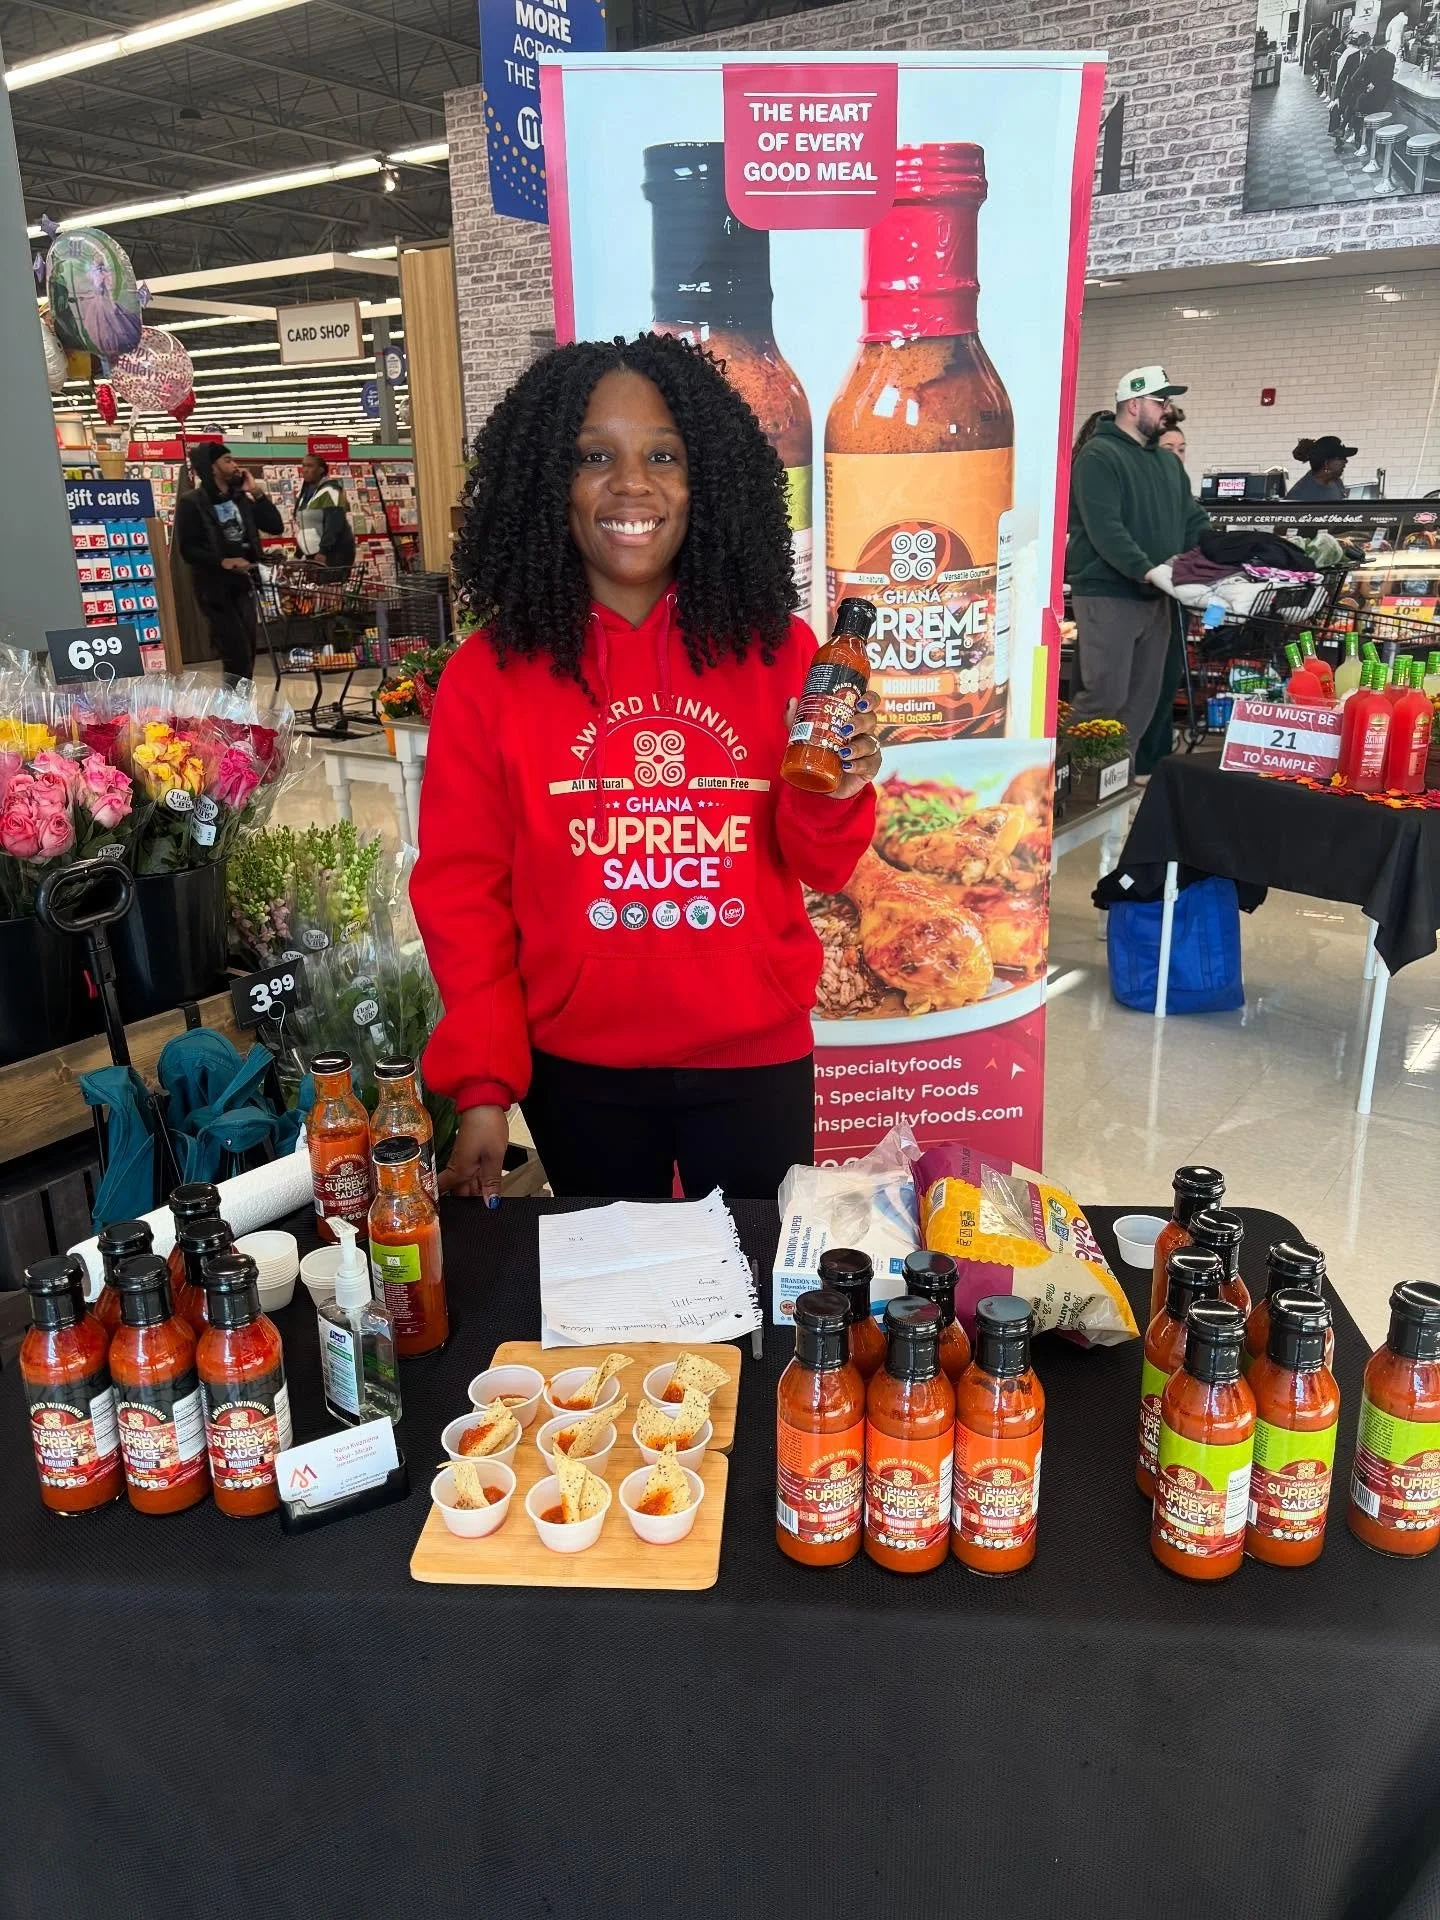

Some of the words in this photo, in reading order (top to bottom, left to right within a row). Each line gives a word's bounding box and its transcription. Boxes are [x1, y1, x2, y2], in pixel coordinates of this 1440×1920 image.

[515, 1, 572, 44] MORE
[504, 60, 536, 90] THE
[749, 103, 793, 122] THE
[799, 103, 872, 122] HEART
[758, 132, 789, 151] OF
[795, 132, 864, 151] EVERY
[743, 162, 811, 181] GOOD
[817, 162, 878, 181] MEAL
[287, 327, 317, 342] CARD
[320, 323, 350, 340] SHOP
[1217, 479, 1245, 490] meijer
[66, 488, 93, 509] gift
[98, 489, 140, 506] cards
[95, 537, 106, 547] 25
[80, 570, 92, 580] 25
[101, 569, 111, 579] 25
[944, 571, 969, 580] Versatile
[882, 588, 941, 604] GHANA
[86, 603, 96, 613] 25
[103, 602, 114, 612] 25
[869, 600, 988, 640] PREME
[885, 700, 936, 712] Medium
[1245, 702, 1273, 718] YOU
[1276, 706, 1314, 724] MUST
[1317, 712, 1337, 726] BE
[571, 696, 643, 761] AWRD
[1270, 729, 1297, 750] 21
[1242, 751, 1260, 764] TO
[1262, 752, 1315, 773] SAMPLE
[571, 780, 585, 790] All
[587, 779, 624, 790] Ntural
[697, 778, 728, 788] Gluten
[730, 779, 749, 789] Free
[626, 796, 693, 813] GHANA
[569, 815, 751, 857] SUPREME
[603, 856, 720, 890] SAUCE
[660, 914, 674, 923] GMO
[724, 907, 741, 916] LOW
[829, 1086, 916, 1106] Specialty
[921, 1081, 979, 1099] Foods
[324, 1175, 368, 1192] SUPREME
[335, 1187, 363, 1200] SAUCE
[1031, 1199, 1042, 1214] THIN
[1063, 1291, 1071, 1301] TO
[46, 1402, 84, 1418] WINNING
[131, 1402, 166, 1421] WINNING
[212, 1402, 233, 1420] AWARD
[234, 1401, 270, 1415] WINNING
[40, 1429, 69, 1438] GHANA
[127, 1429, 153, 1438] GHANA
[212, 1430, 273, 1449] SUPREME
[225, 1429, 258, 1438] GHANA
[41, 1447, 78, 1458] SAUCE
[126, 1446, 160, 1460] SAUCE
[224, 1444, 265, 1459] SAUCE
[44, 1458, 74, 1468] MARINADE
[228, 1458, 262, 1468] MARINADE
[809, 1453, 835, 1472] AWARD
[901, 1458, 935, 1479] WINNING
[972, 1458, 998, 1472] AWARD
[1001, 1458, 1031, 1473] WINNING
[805, 1475, 862, 1501] SUPREME
[823, 1478, 852, 1490] GHANA
[886, 1486, 919, 1497] GHANA
[985, 1486, 1017, 1495] GHANA
[873, 1484, 936, 1509] SUPREME
[967, 1487, 1032, 1507] SUPREME
[1159, 1480, 1221, 1515] SUPREME
[1173, 1485, 1198, 1500] GHANA
[818, 1493, 855, 1512] SAUCE
[1281, 1499, 1321, 1510] SAUCE
[882, 1504, 924, 1518] SAUCE
[980, 1504, 1021, 1518] SAUCE
[1165, 1500, 1206, 1525] SAUCE
[889, 1526, 915, 1535] Medium
[986, 1526, 1013, 1534] Medium
[1175, 1528, 1189, 1538] Mild
